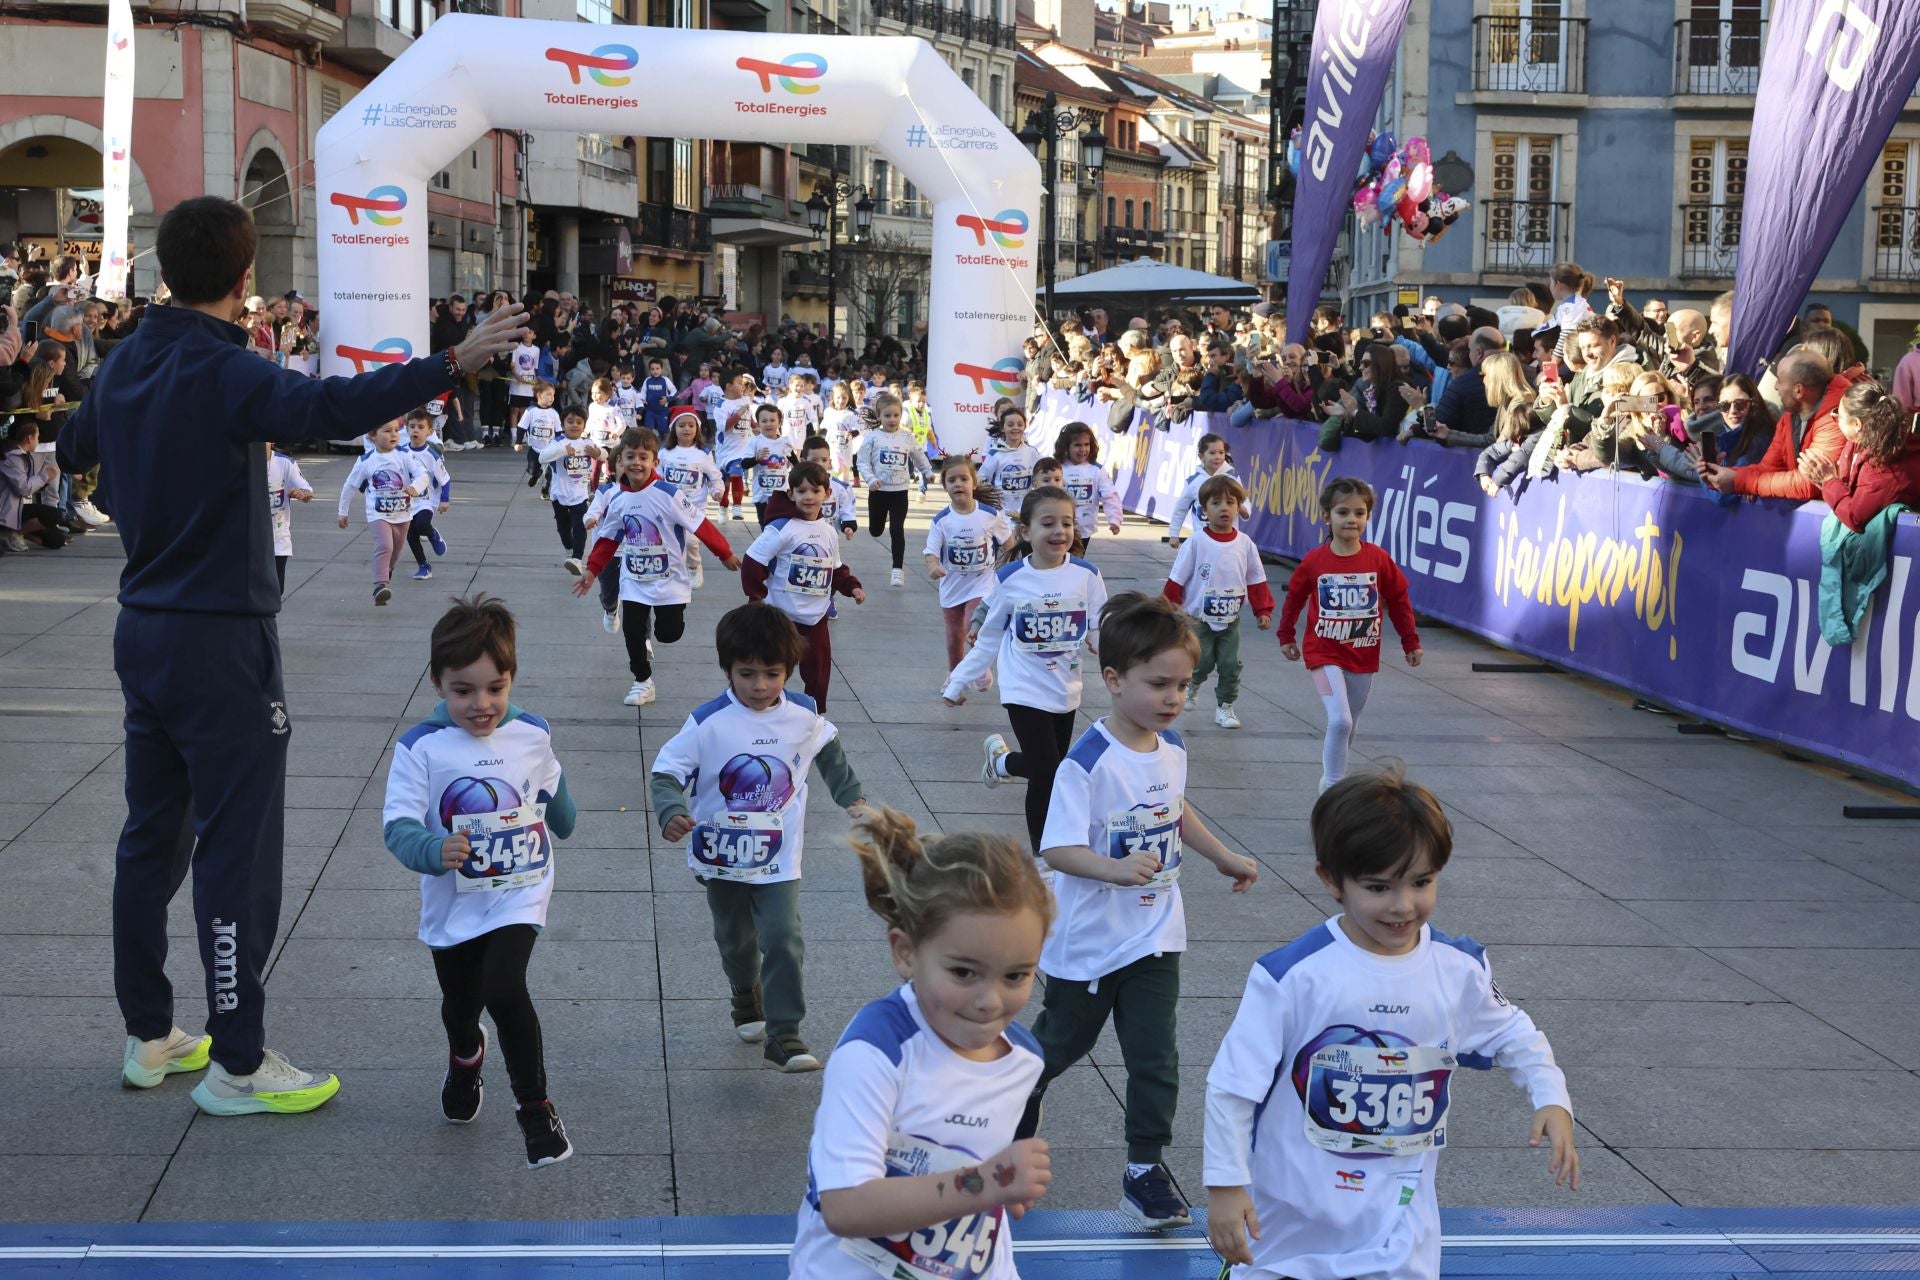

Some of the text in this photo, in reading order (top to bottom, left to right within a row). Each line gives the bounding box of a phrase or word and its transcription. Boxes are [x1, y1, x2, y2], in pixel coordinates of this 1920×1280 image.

[544, 93, 638, 109] TotalEnergies
[735, 101, 828, 117] TotalEnergies
[383, 116, 457, 128] LasCarreras
[928, 137, 999, 150] LasCarreras
[331, 234, 410, 247] TotalEnergies
[955, 254, 1028, 269] TotalEnergies
[334, 291, 411, 302] totalenergies.es
[954, 311, 1027, 322] totalenergies.es
[379, 499, 407, 511] 3323
[1366, 464, 1478, 584] vilés
[953, 547, 985, 563] 3373
[629, 556, 663, 573] 3549
[1328, 588, 1370, 607] 3103
[1024, 615, 1079, 639] 3584
[732, 791, 774, 801] SILVESTRE
[755, 783, 772, 793] SAN
[470, 830, 545, 872] 3452
[702, 831, 771, 863] 3405
[1316, 1053, 1353, 1065] SILVESTRE
[1328, 1079, 1436, 1128] 3365
[886, 1213, 997, 1274] 345
